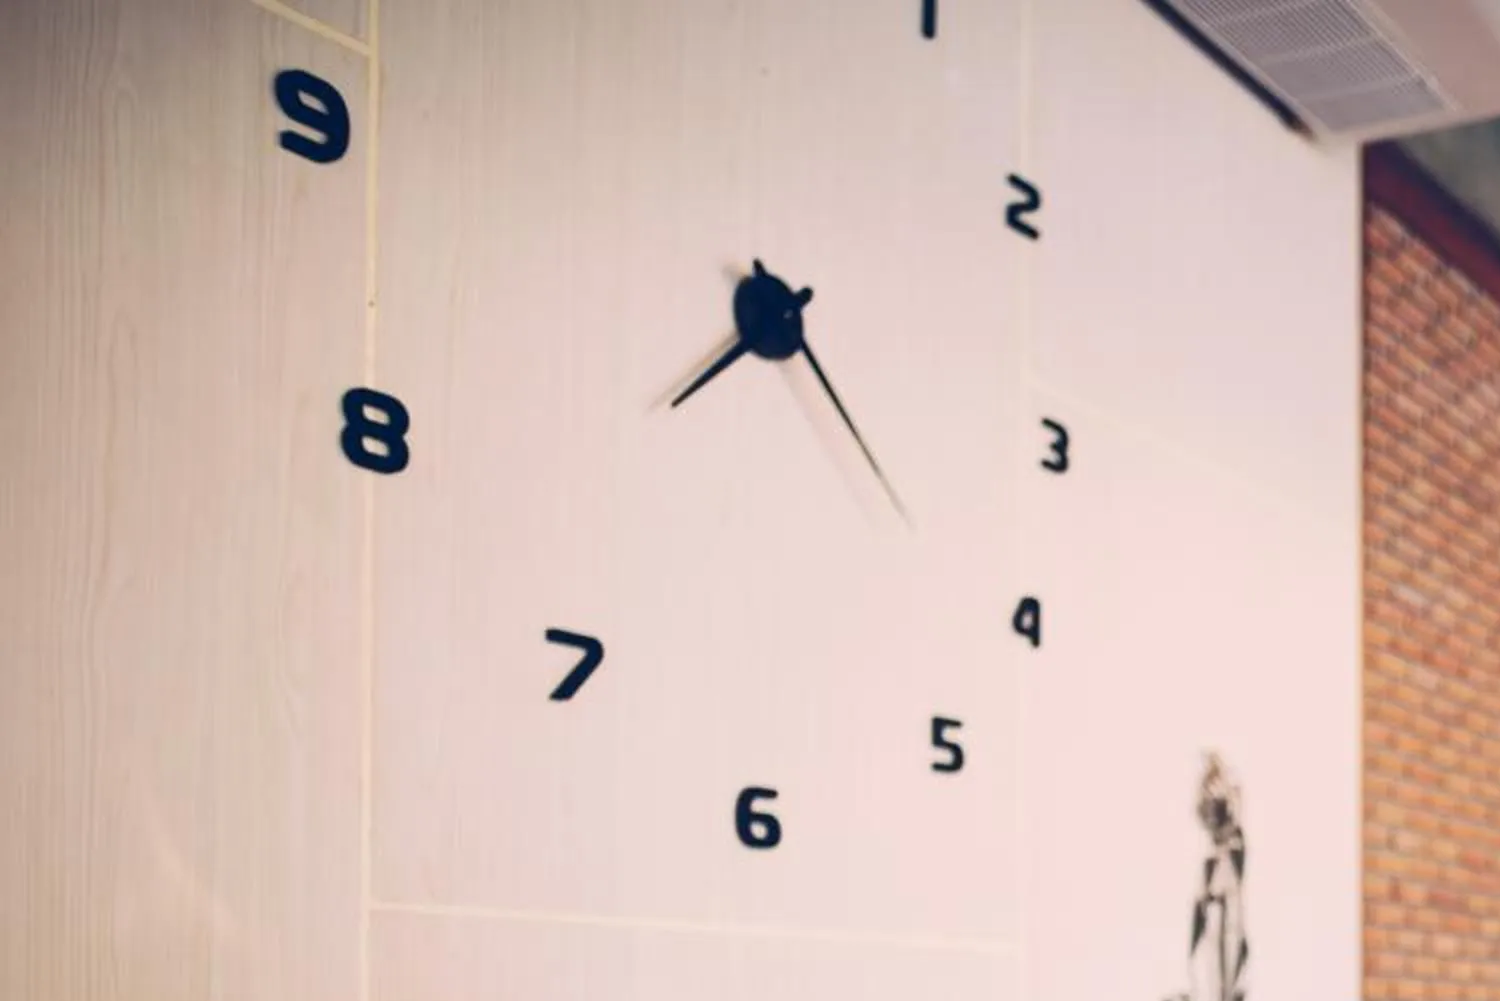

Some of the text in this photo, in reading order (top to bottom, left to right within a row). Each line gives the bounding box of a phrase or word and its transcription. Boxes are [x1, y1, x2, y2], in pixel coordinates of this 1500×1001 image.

[271, 68, 351, 164] 9
[1005, 174, 1041, 240] 2
[340, 387, 410, 475] 8
[1041, 418, 1069, 473] 3
[1012, 597, 1040, 647] 4
[545, 629, 604, 701] 7
[932, 717, 964, 773] 5
[735, 787, 781, 849] 6
